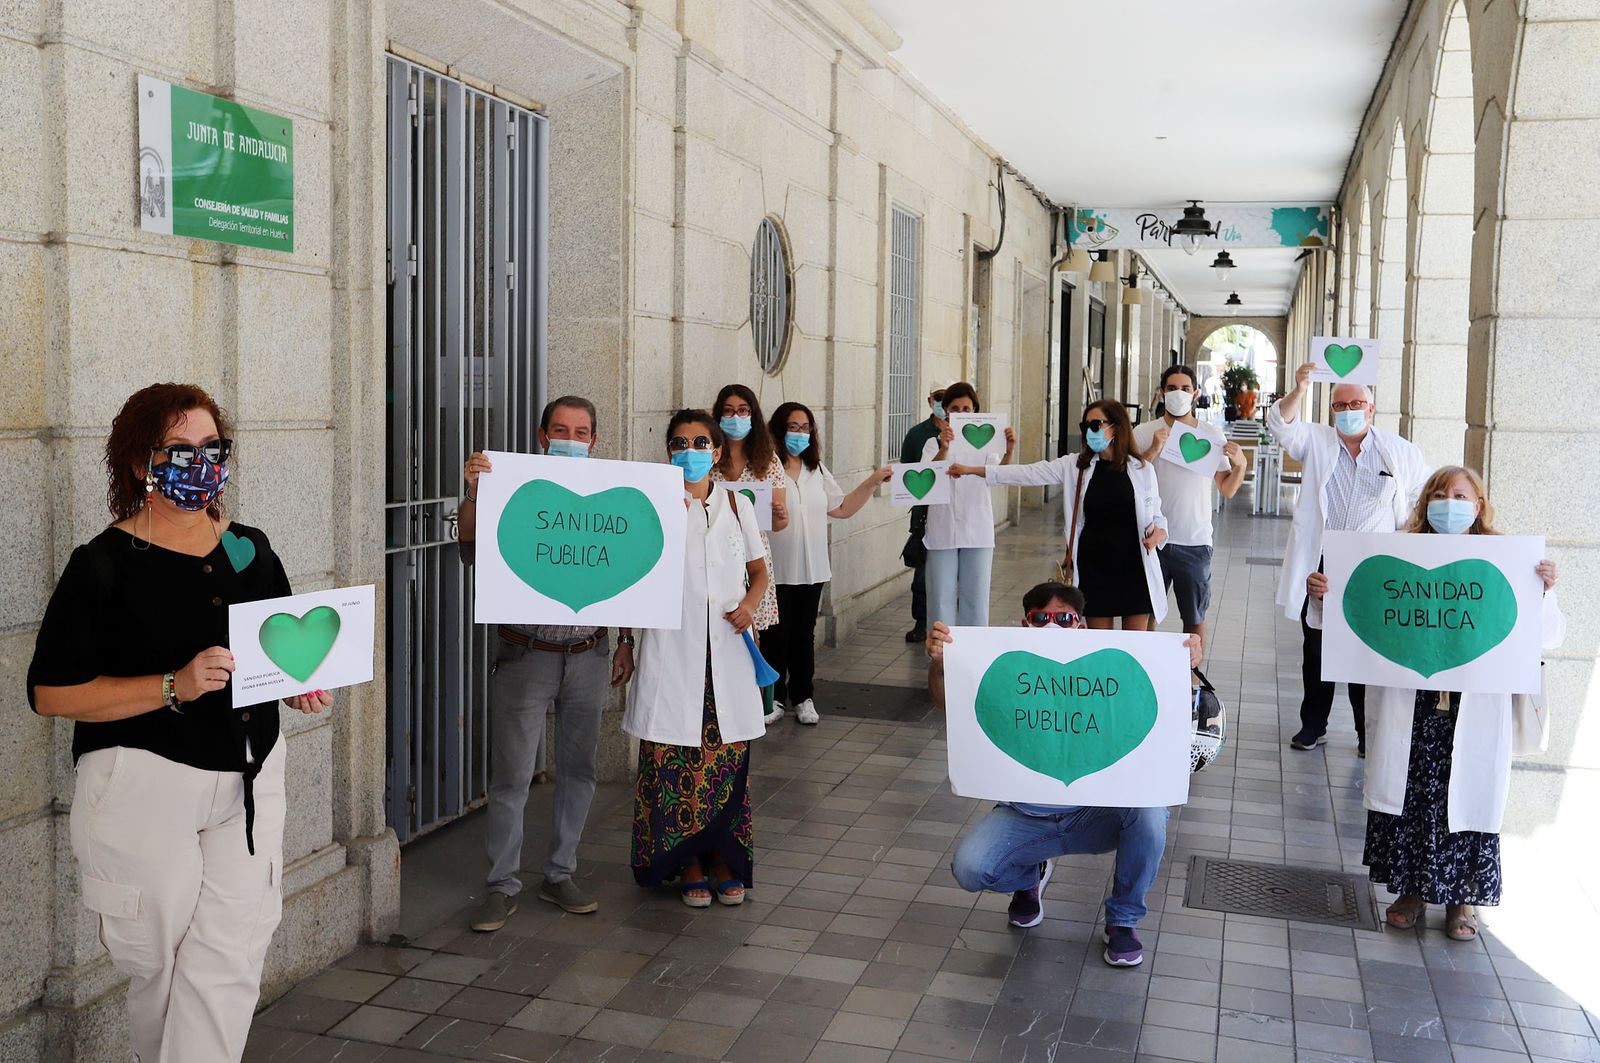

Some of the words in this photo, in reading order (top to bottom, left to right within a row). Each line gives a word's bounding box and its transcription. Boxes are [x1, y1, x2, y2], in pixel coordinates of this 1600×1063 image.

[186, 121, 219, 147] JUNTA
[222, 130, 235, 151] DE
[208, 216, 238, 231] Delegación
[239, 222, 262, 236] Territorial
[262, 228, 269, 236] en
[232, 205, 241, 215] DE
[241, 206, 260, 219] SALUD
[260, 211, 265, 220] Y
[264, 211, 289, 225] FAMILIAS
[535, 510, 628, 535] SANIDAD
[535, 542, 611, 568] PUBLICA
[1383, 579, 1483, 601] SANIDAD
[1384, 607, 1475, 630] PUBLICA
[243, 674, 262, 682] SANIDAD
[1015, 672, 1119, 697] SANIDAD
[1014, 708, 1100, 734] PUBLICA
